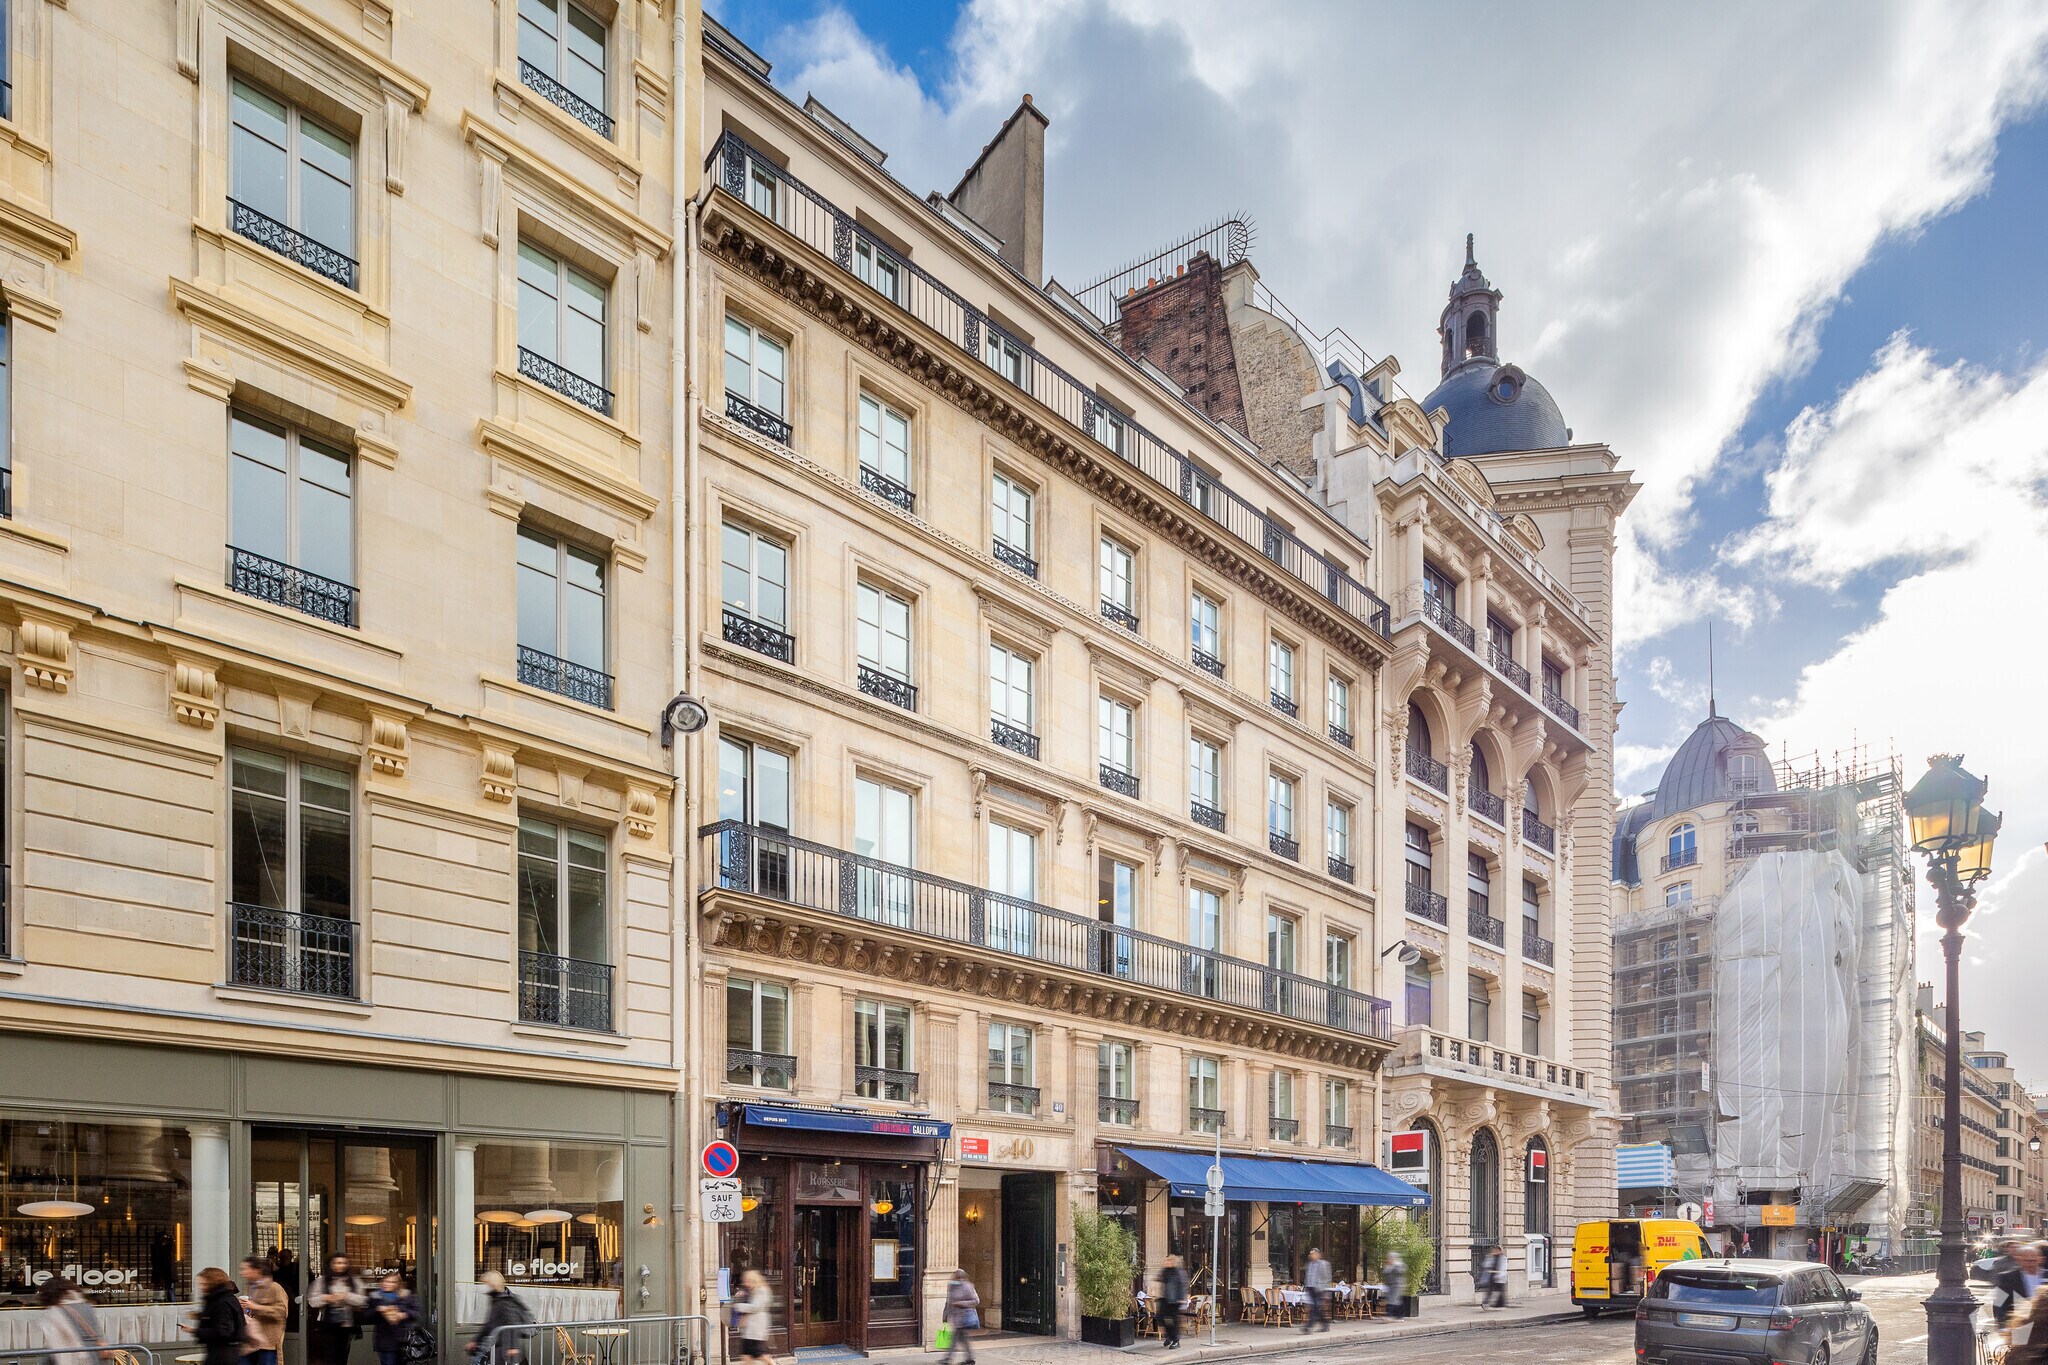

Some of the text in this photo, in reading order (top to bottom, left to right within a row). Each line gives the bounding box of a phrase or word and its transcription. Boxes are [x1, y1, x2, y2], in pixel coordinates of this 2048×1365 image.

[1054, 1103, 1063, 1112] 40
[912, 1125, 939, 1136] GALLOPIN
[1010, 1138, 1034, 1160] 40
[711, 1194, 733, 1202] SAUF
[1657, 1236, 1678, 1246] DHL
[507, 1258, 578, 1276] le floor
[25, 1264, 138, 1286] le floor
